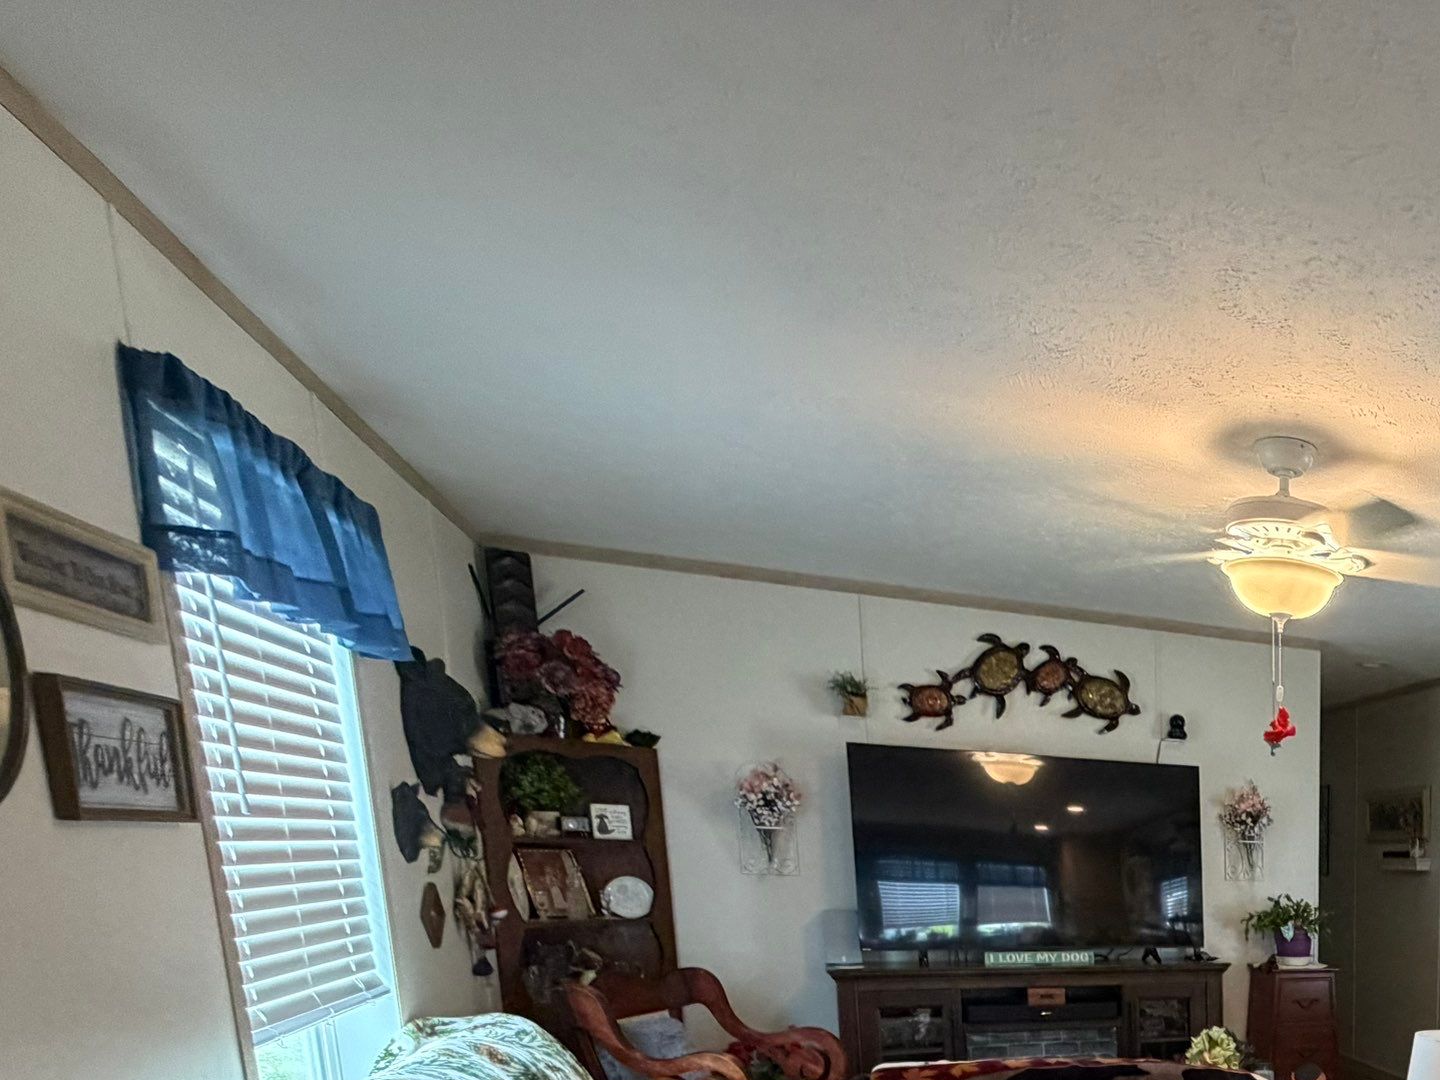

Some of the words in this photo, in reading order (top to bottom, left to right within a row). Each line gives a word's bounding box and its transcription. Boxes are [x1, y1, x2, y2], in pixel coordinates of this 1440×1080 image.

[989, 953, 994, 963] I
[999, 952, 1032, 963] LOVE
[1036, 952, 1057, 962] MY
[1061, 951, 1089, 961] DOG
